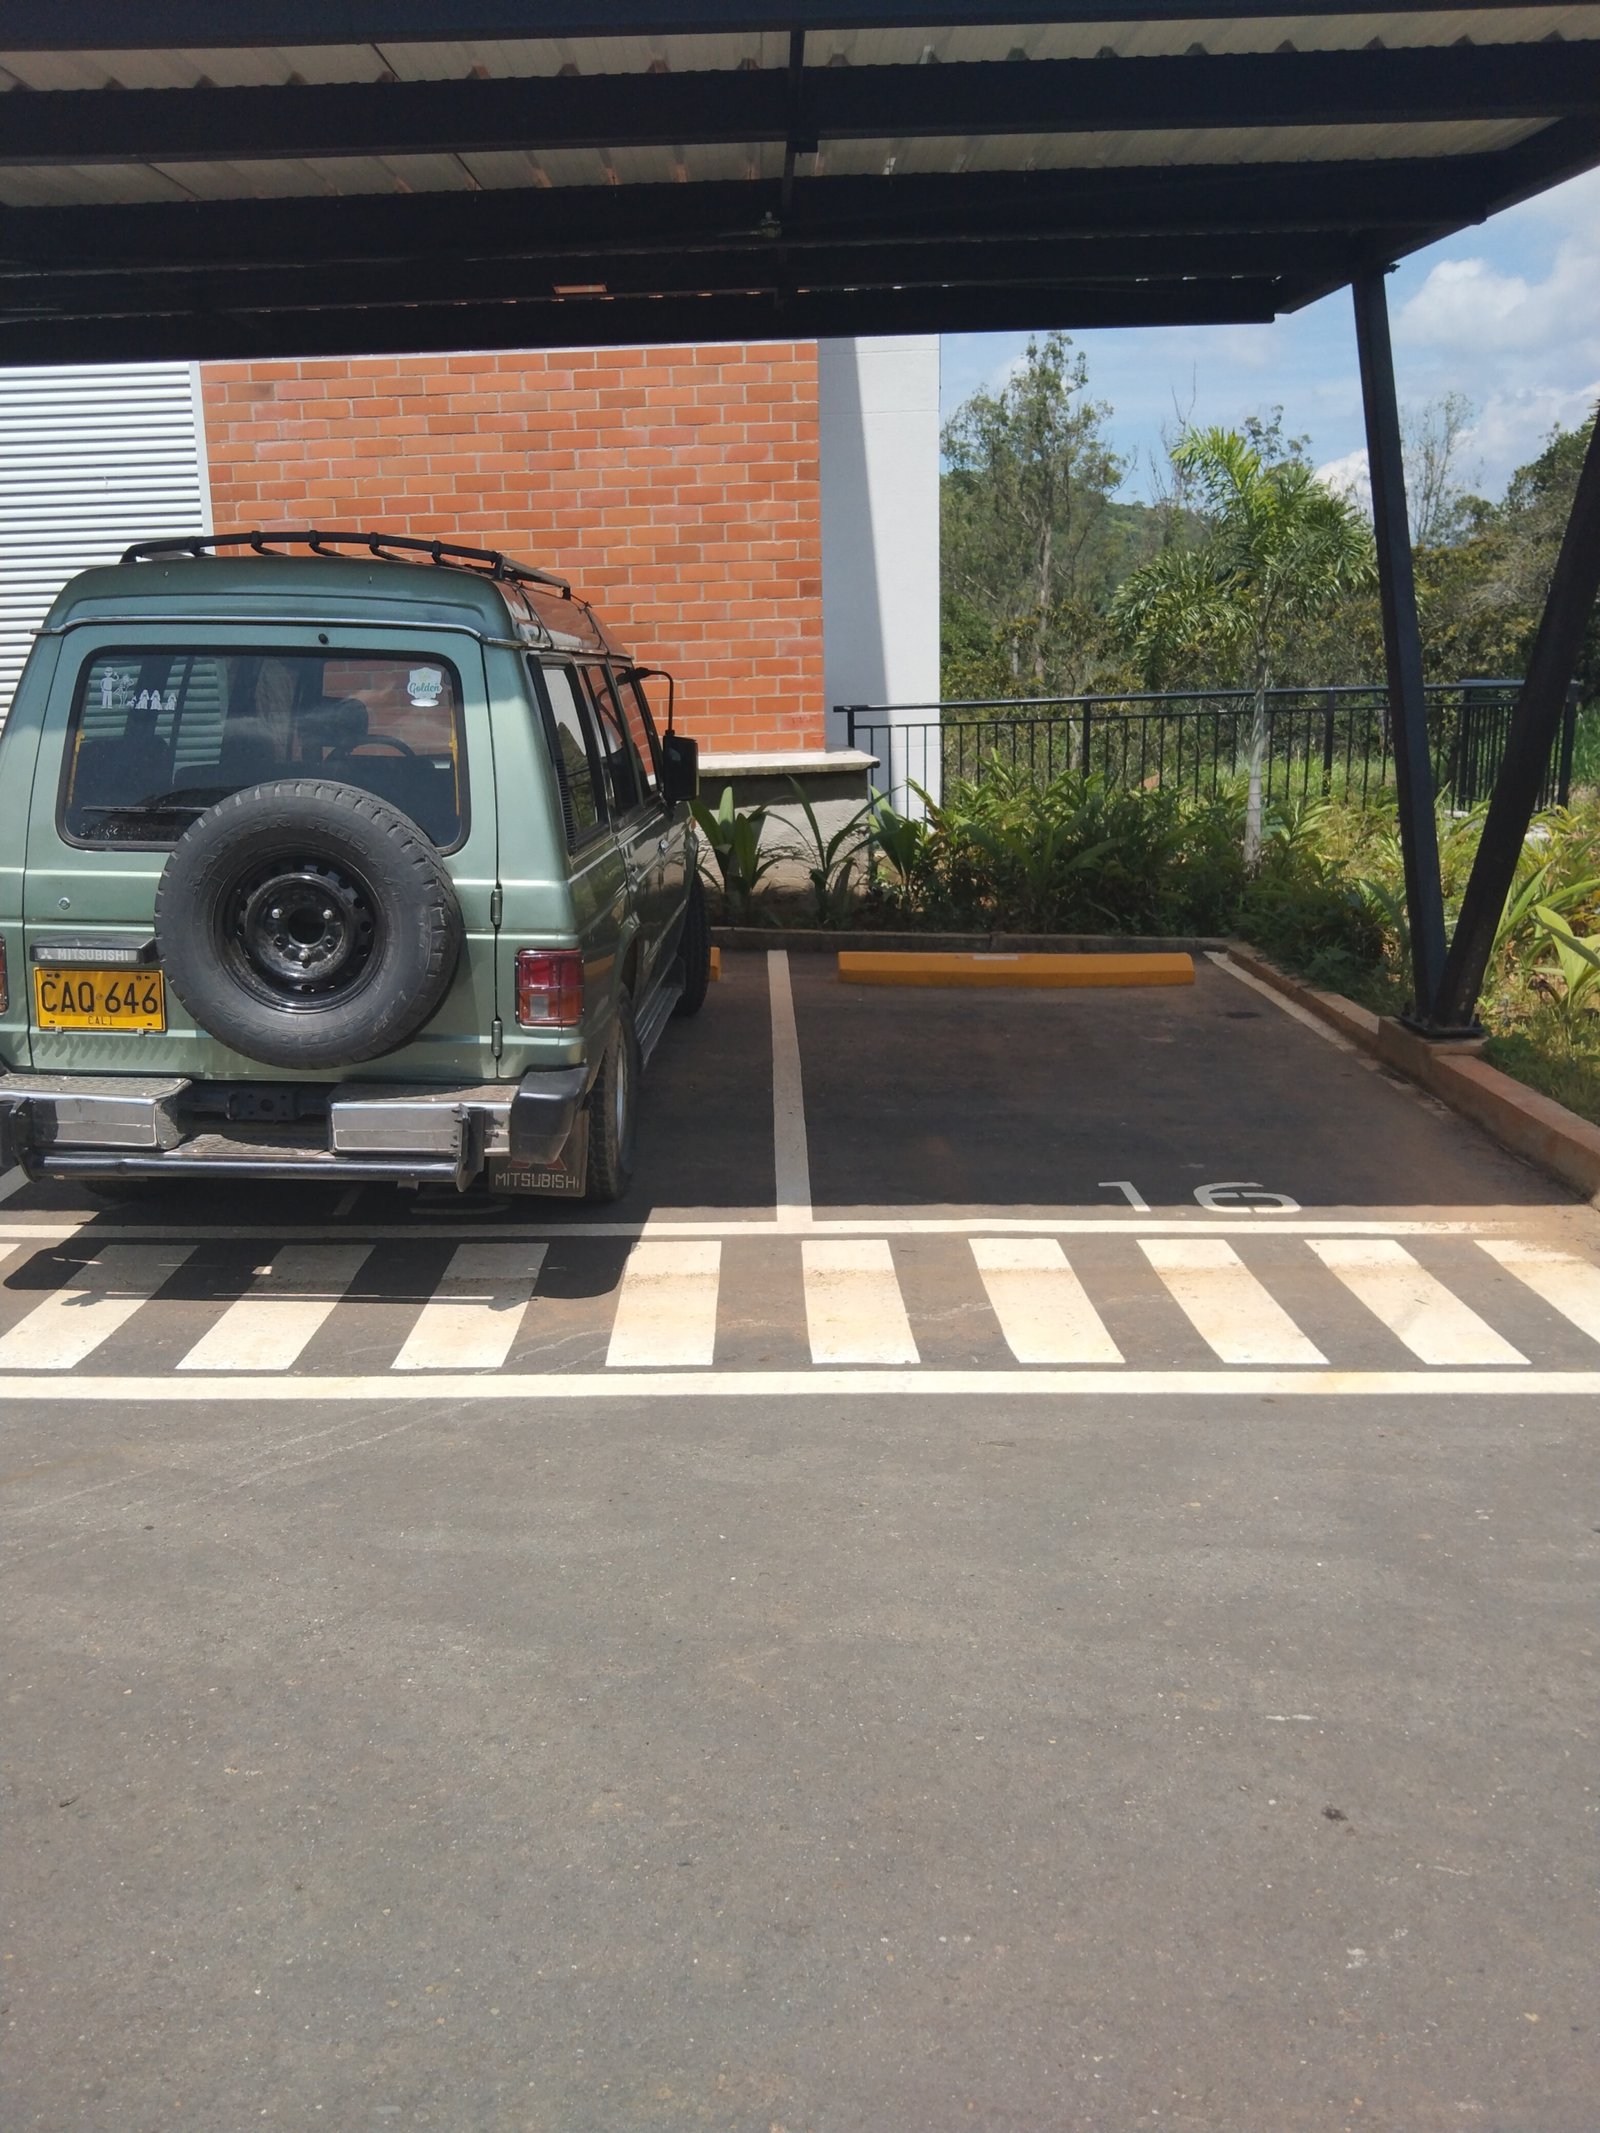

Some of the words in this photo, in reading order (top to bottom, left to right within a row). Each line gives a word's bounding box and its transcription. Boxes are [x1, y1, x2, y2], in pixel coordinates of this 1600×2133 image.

[409, 682, 441, 694] Golden
[57, 948, 129, 961] MITSUBISHI
[41, 981, 94, 1013] CAQ
[105, 982, 158, 1014] 646
[87, 1015, 113, 1026] CALI
[495, 1172, 580, 1189] MITSUBISHI
[1098, 1181, 1303, 1213] 16
